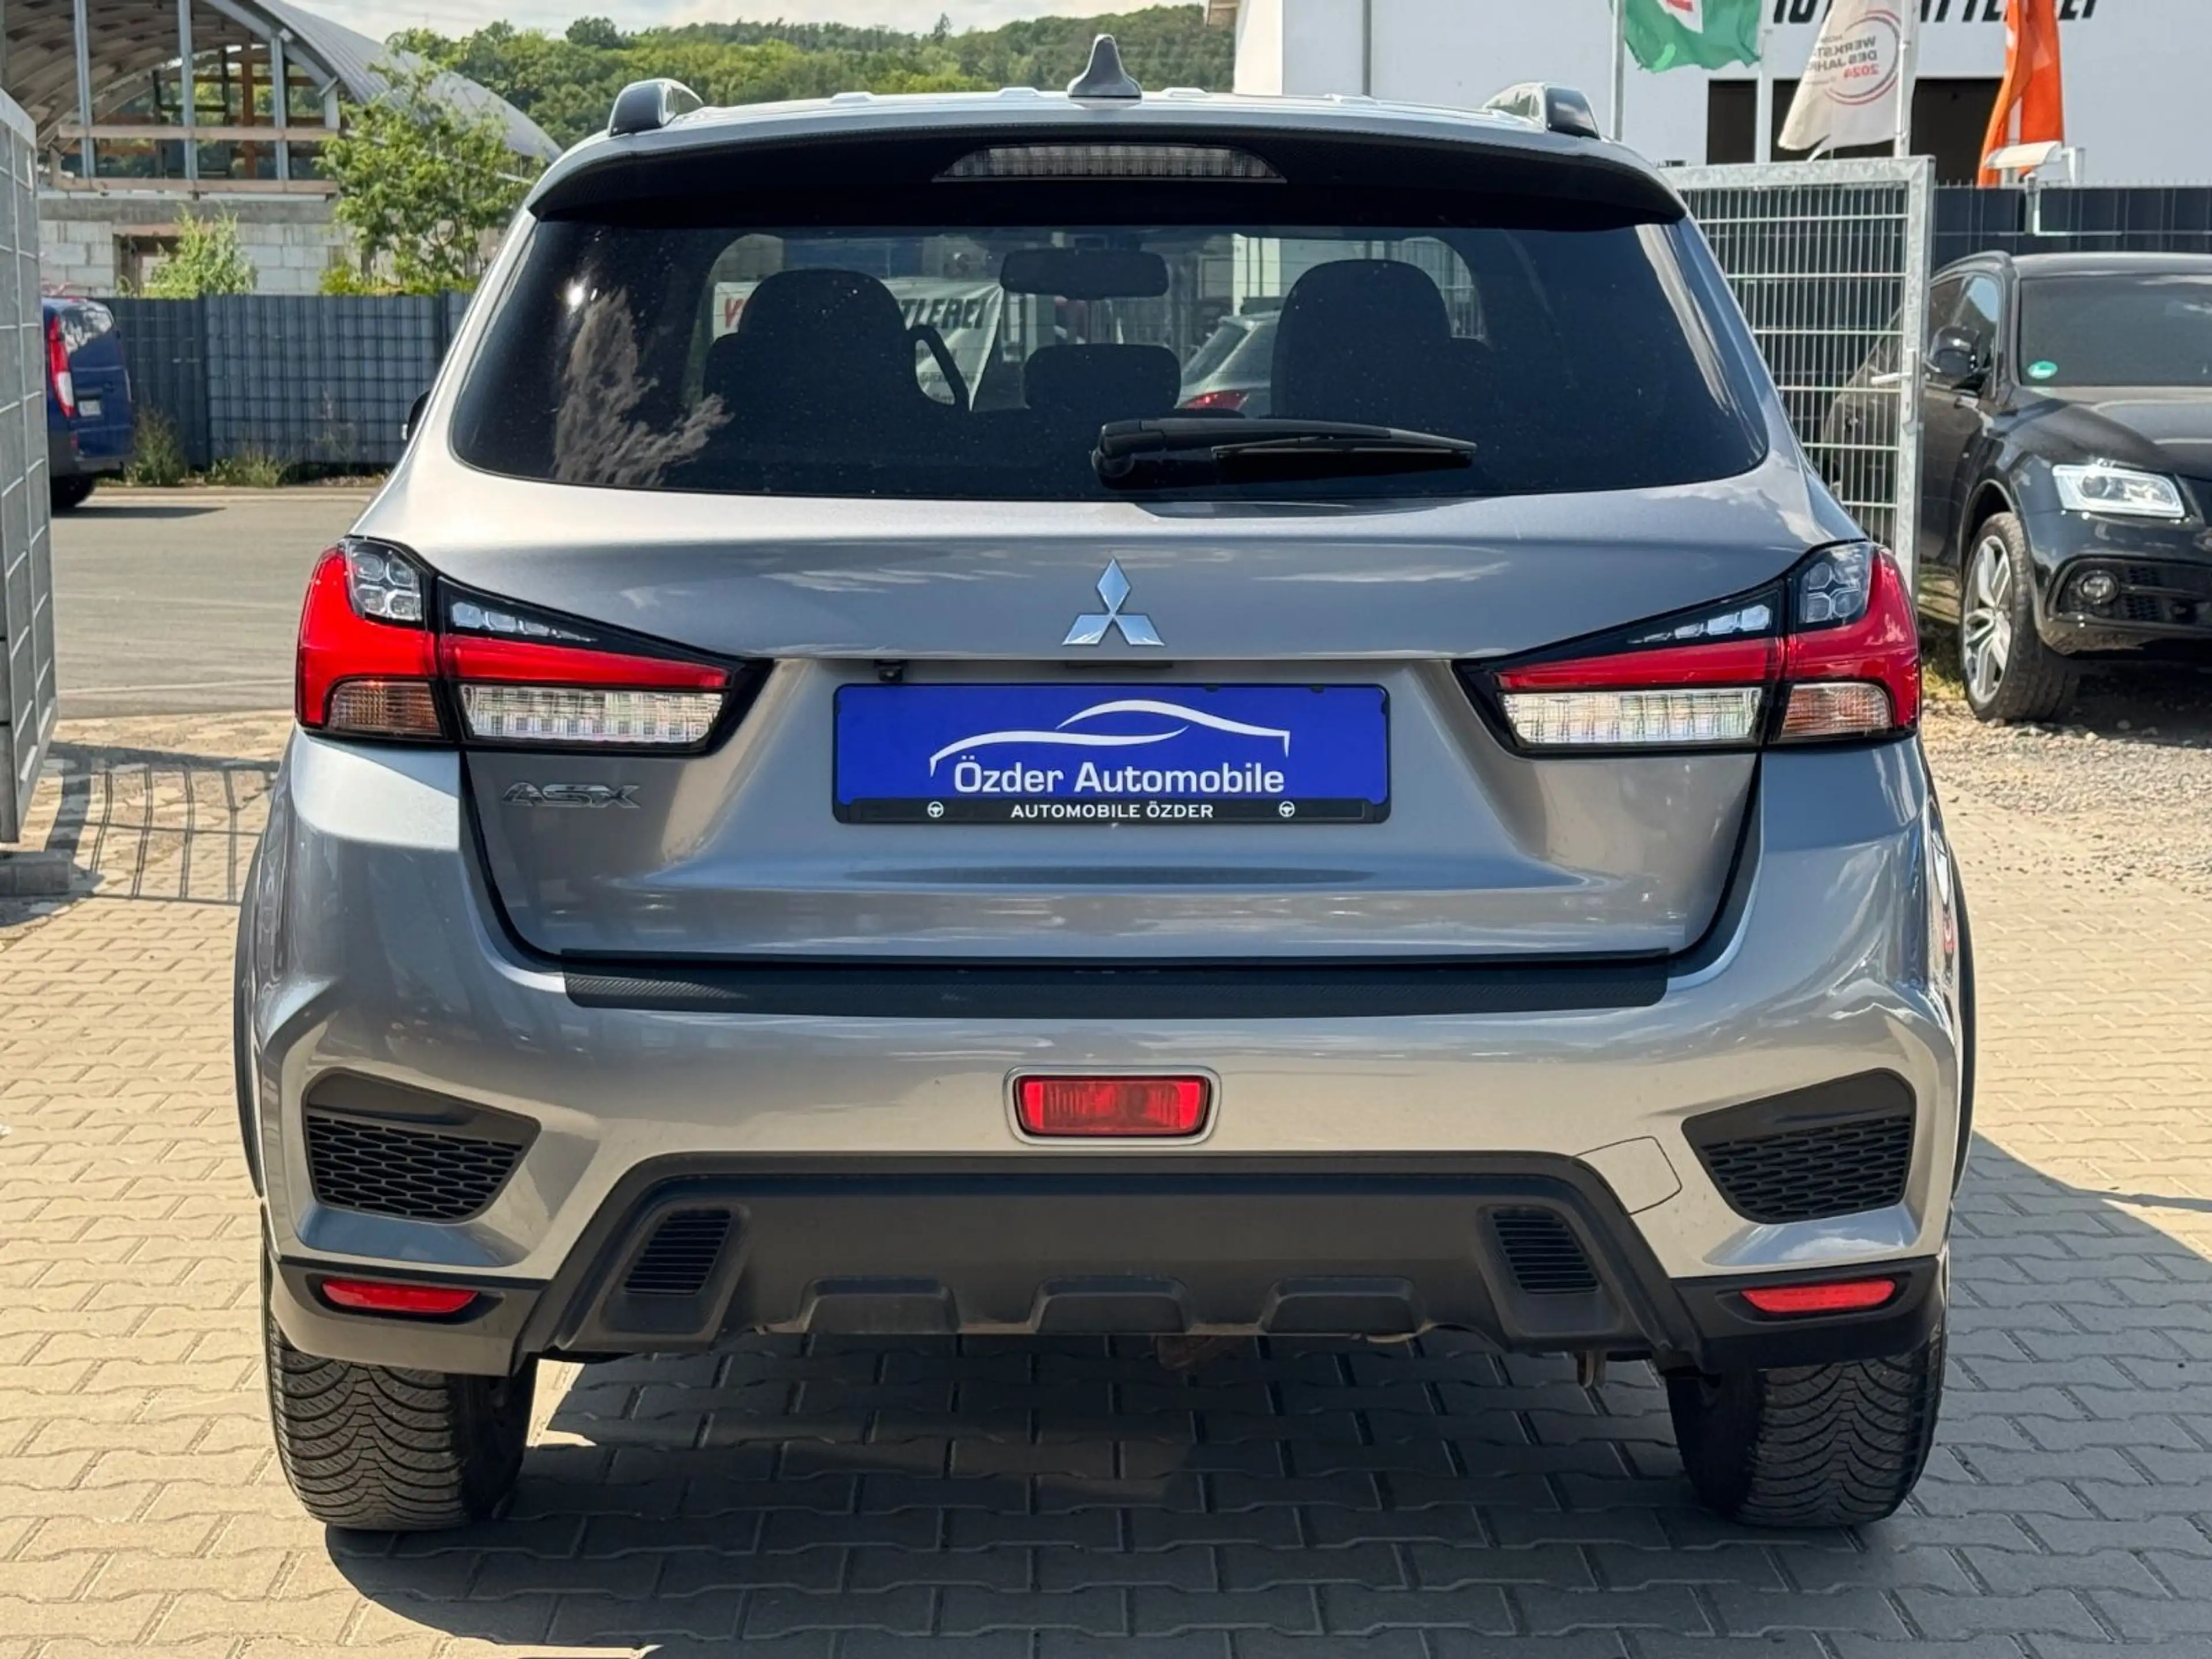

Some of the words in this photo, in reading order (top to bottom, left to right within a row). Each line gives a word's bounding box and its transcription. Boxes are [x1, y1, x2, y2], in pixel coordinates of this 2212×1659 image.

[900, 298, 986, 328] TLEREI
[955, 755, 1064, 793] Özder
[1074, 762, 1285, 793] Automobile
[501, 782, 641, 808] ASX
[1010, 804, 1141, 818] AUTOMOBILE
[1147, 801, 1213, 818] ÖZDER
